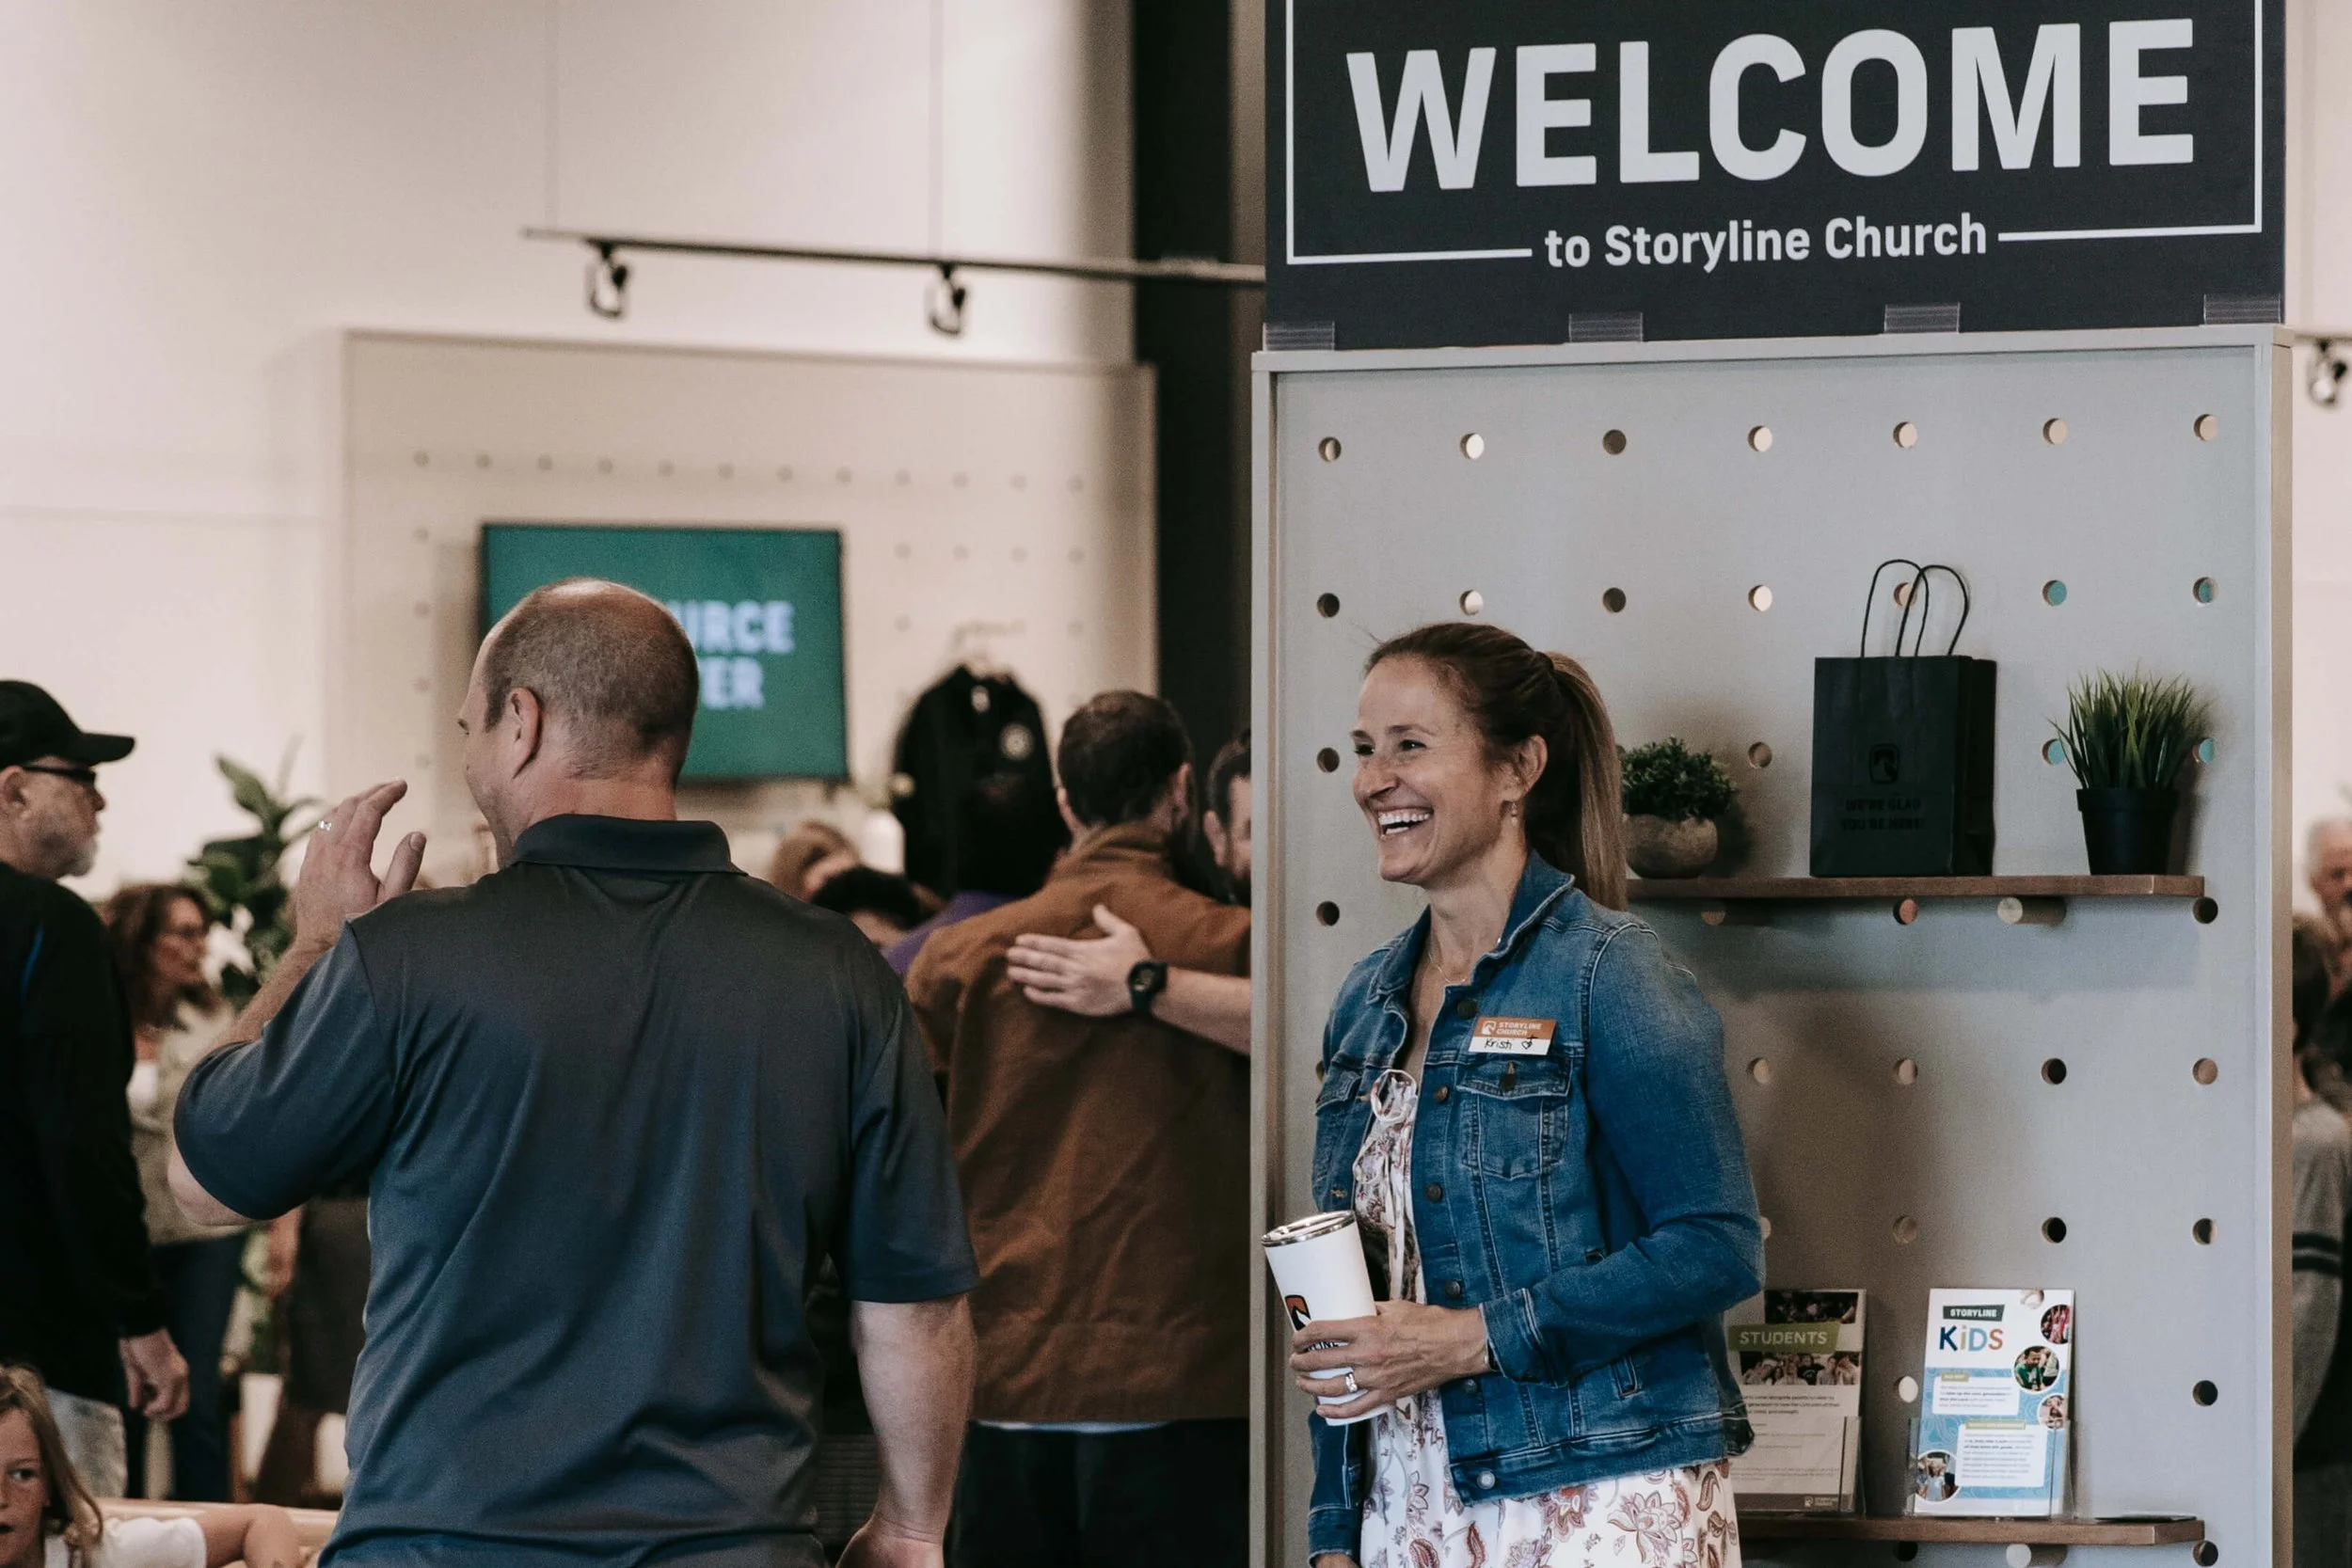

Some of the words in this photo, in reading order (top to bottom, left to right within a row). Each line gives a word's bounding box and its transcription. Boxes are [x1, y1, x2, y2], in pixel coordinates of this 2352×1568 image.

[1346, 19, 2193, 192] WELCOME
[1545, 230, 1589, 267] to
[1605, 220, 1809, 273] Storyline
[1826, 213, 1986, 259] Church
[1498, 1022, 1542, 1030] STORYLINE
[1949, 1307, 1997, 1318] STORYLINE
[1740, 1331, 1828, 1345] STUDENTS
